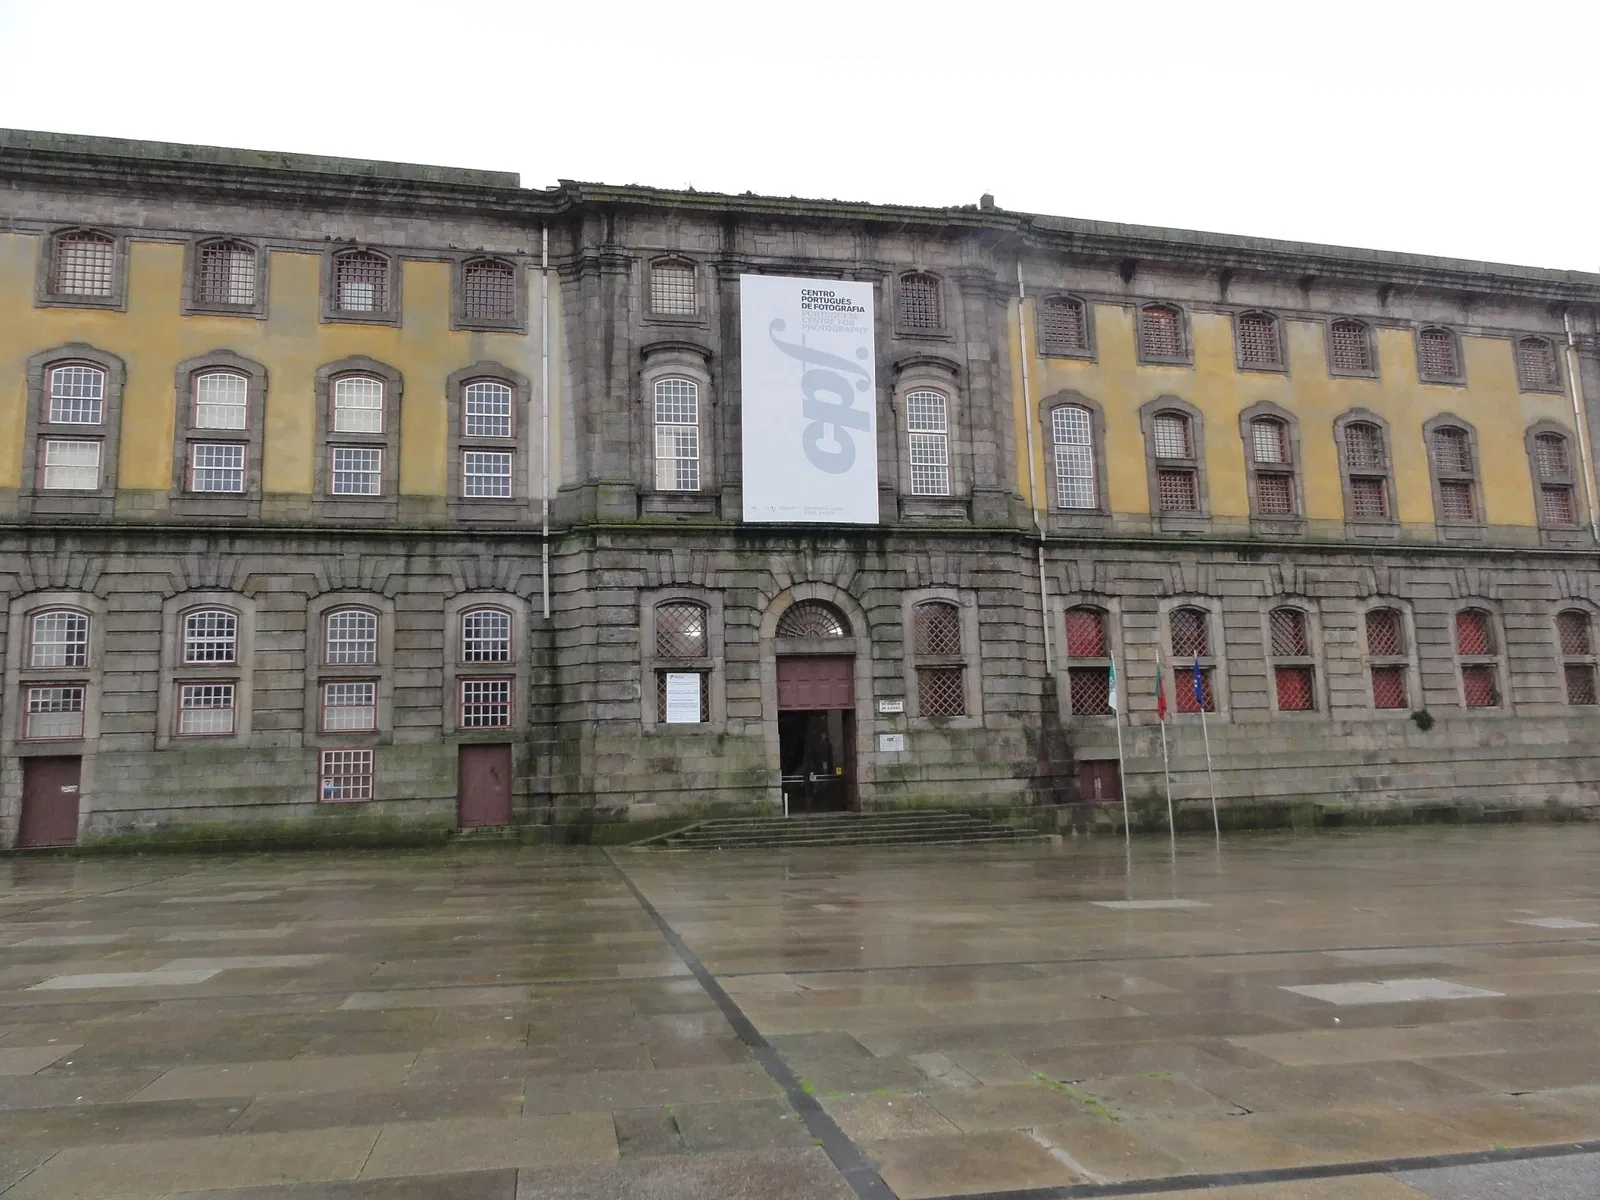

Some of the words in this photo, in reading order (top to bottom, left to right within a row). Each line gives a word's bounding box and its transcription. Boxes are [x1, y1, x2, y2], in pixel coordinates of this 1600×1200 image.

[802, 289, 835, 297] CENTRO
[802, 296, 852, 305] PORTUGUÊS
[814, 304, 865, 312] FOTOGRAFIA
[802, 311, 861, 319] PORTUGUESE
[802, 317, 836, 325] CENTRE
[837, 318, 856, 326] FOR
[802, 324, 869, 333] PHOTOGRAPHY
